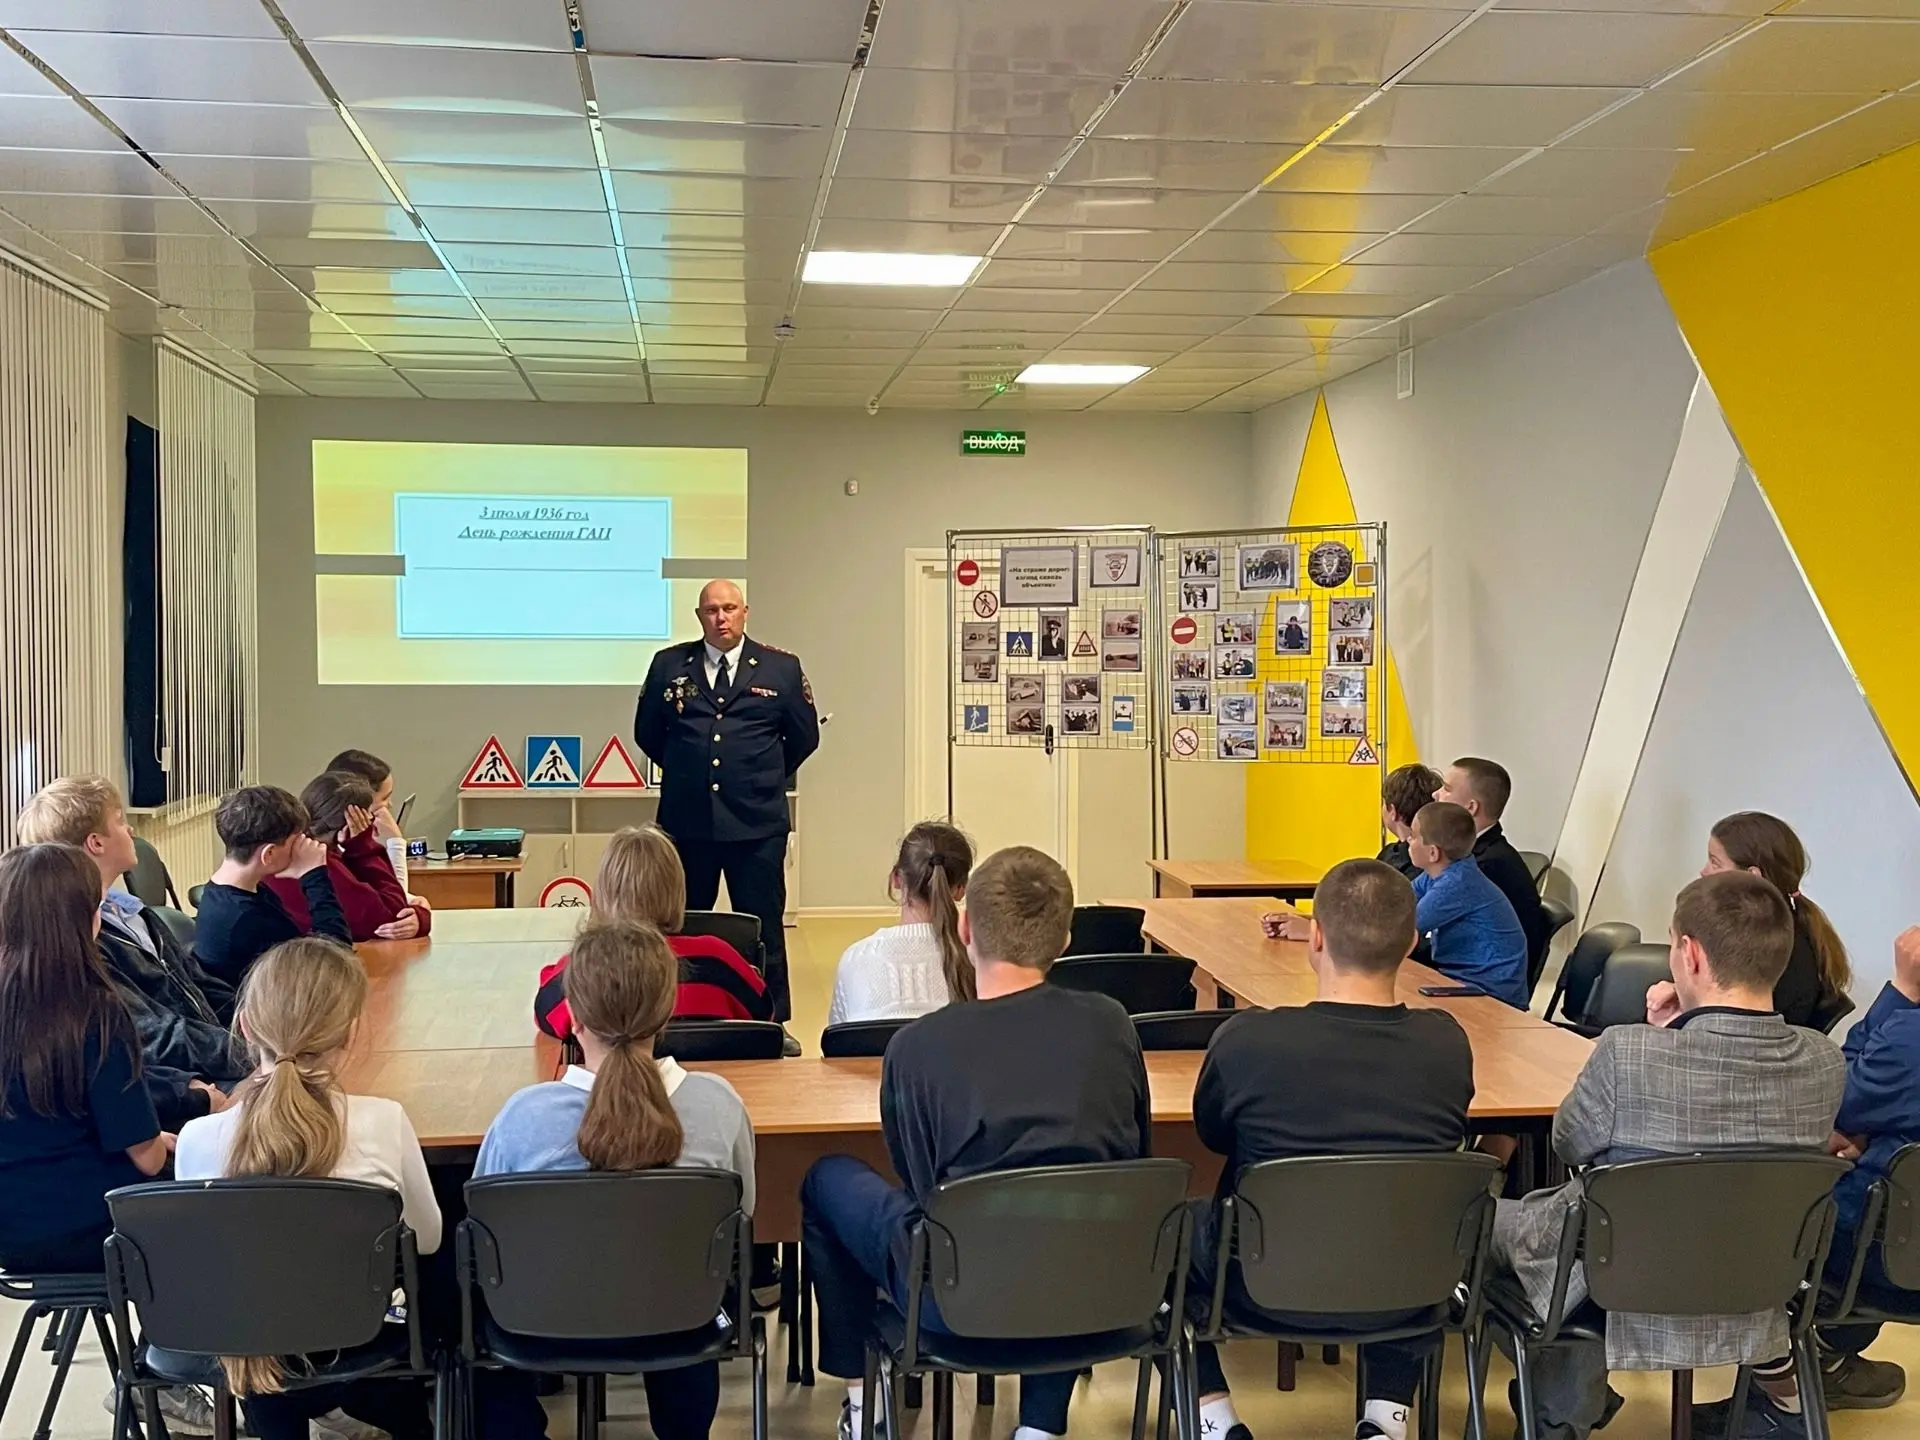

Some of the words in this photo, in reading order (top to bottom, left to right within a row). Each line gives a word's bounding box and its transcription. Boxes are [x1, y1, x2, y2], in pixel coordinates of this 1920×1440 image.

[969, 435, 1019, 452] ВЫХОД
[479, 506, 488, 520] 3
[491, 510, 530, 520] июля
[534, 507, 564, 520] 1936
[565, 511, 589, 521] год
[457, 526, 496, 539] День
[499, 529, 575, 541] рождения
[577, 527, 613, 541] ГАИ
